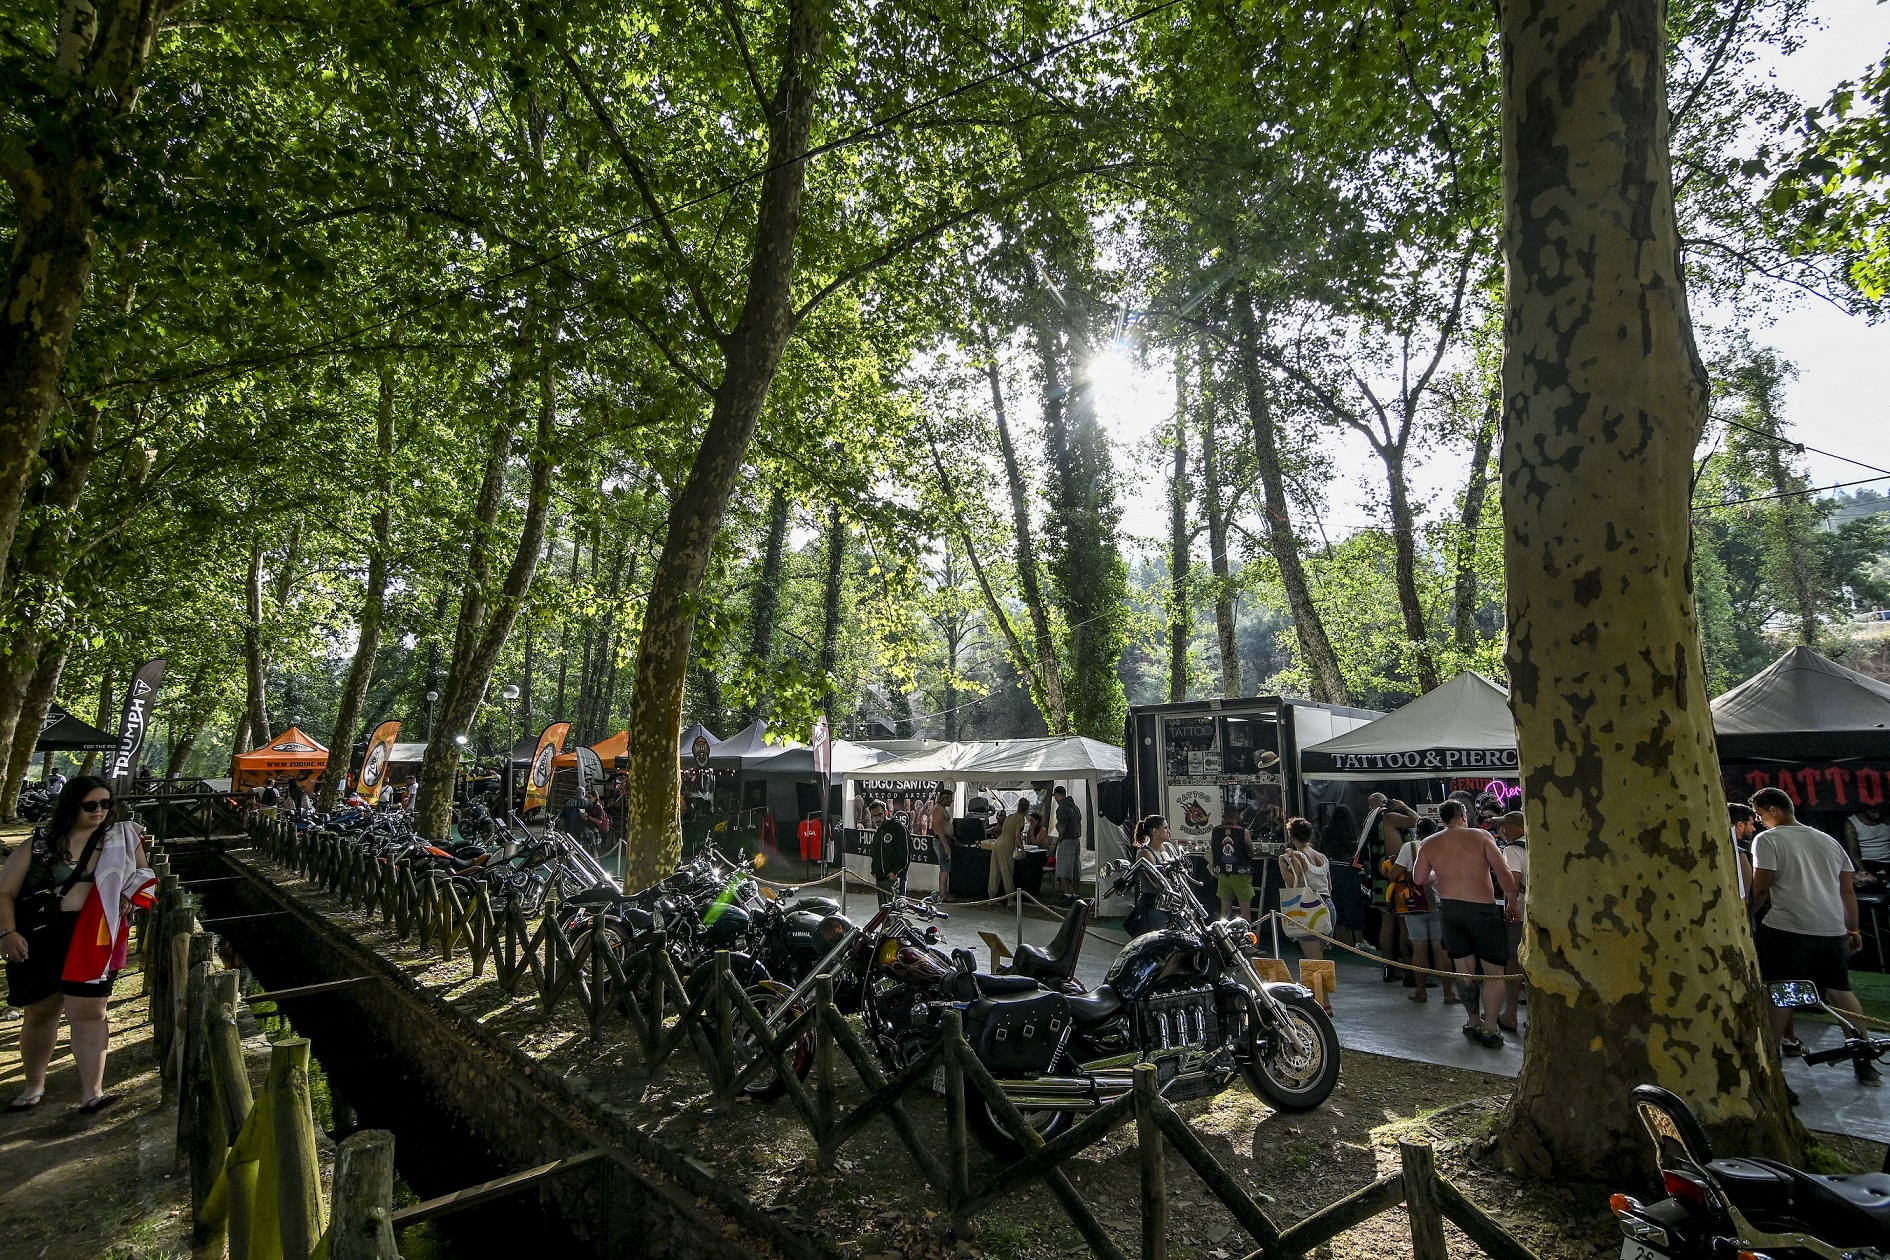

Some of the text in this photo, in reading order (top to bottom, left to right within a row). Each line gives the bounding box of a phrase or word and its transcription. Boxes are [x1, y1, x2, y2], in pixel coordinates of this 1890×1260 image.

[112, 698, 146, 779] TRIUMPH
[1169, 725, 1213, 737] TATTOO
[1330, 749, 1517, 768] TATTOO & PIERC
[896, 780, 938, 790] SANTOS
[1484, 780, 1521, 806] Pier
[1176, 790, 1212, 804] TATTOO
